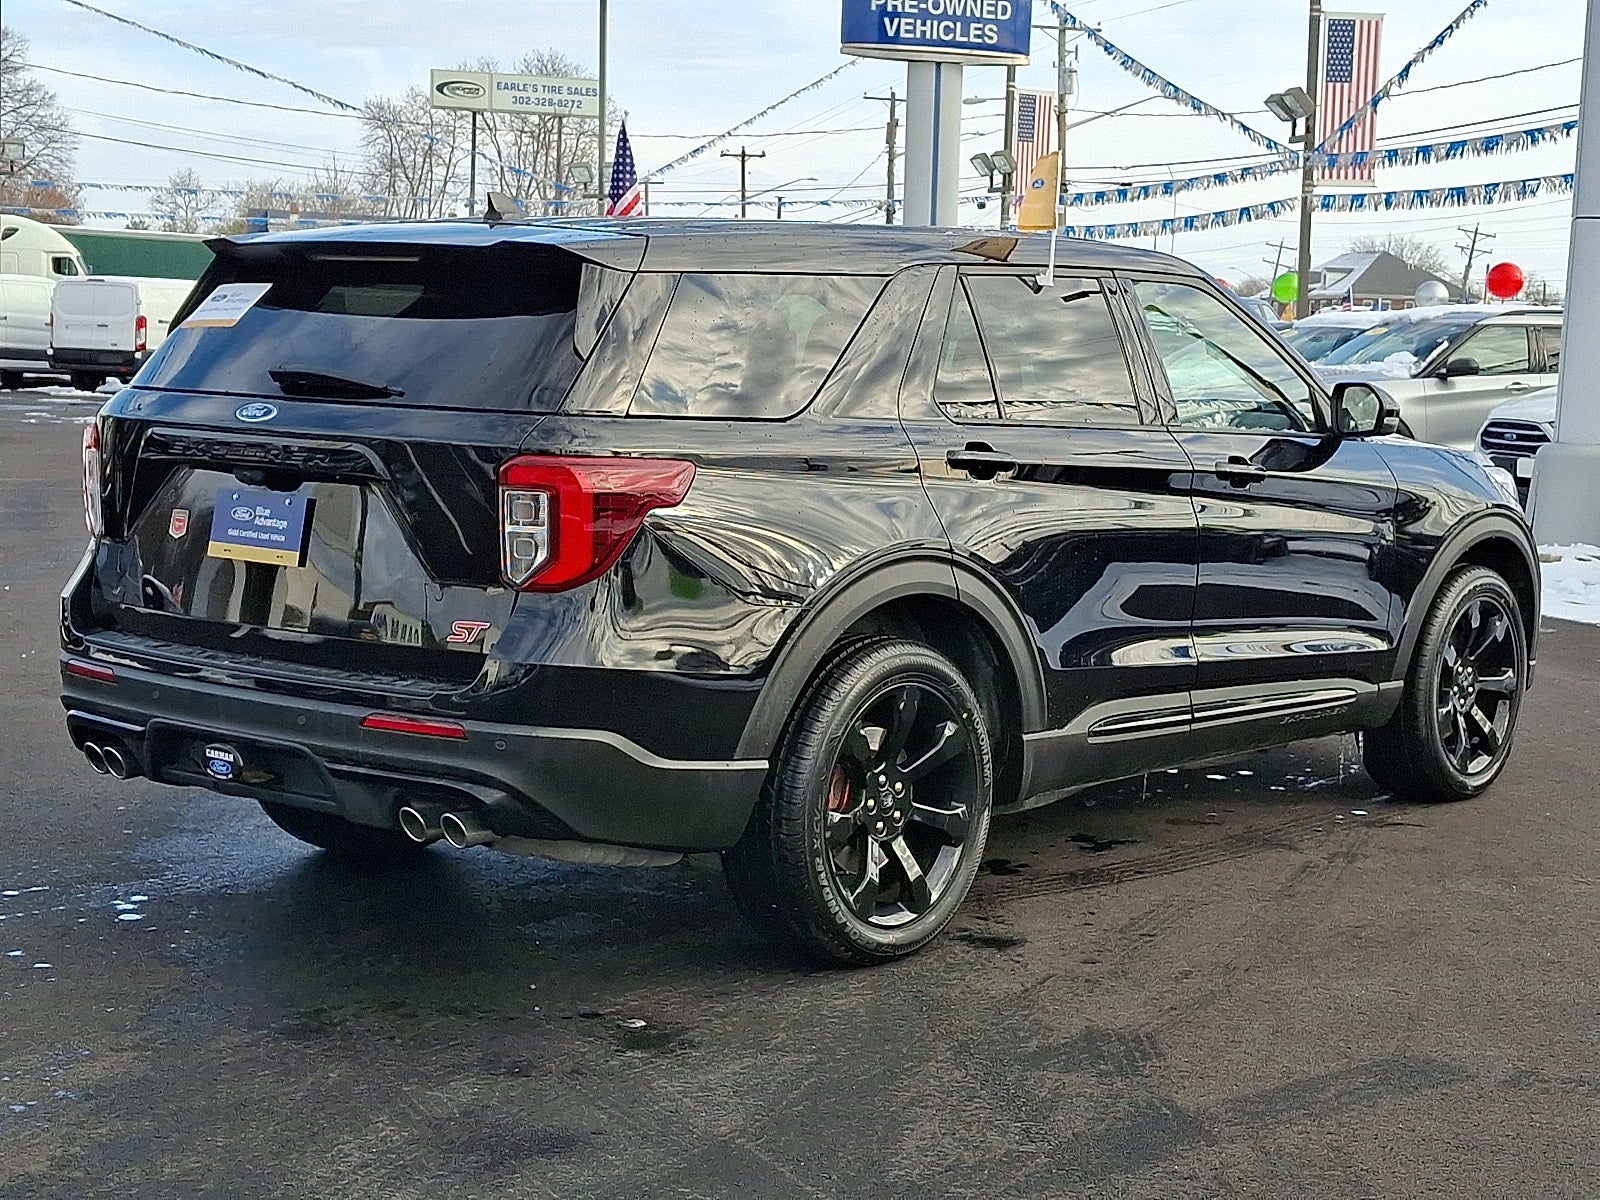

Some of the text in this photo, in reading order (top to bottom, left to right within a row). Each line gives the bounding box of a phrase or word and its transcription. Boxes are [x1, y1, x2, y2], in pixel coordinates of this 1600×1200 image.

[871, 0, 1012, 20] PRE-OWNED
[884, 17, 999, 44] VEHICLES
[496, 81, 598, 97] EARLE'S TIRE SALES
[511, 95, 583, 109] 302-328-8272
[255, 506, 271, 517] Blue
[254, 516, 288, 530] Advantage
[227, 528, 286, 542] Gold Certified Used Vehicle
[446, 620, 491, 643] ST
[206, 748, 234, 762] CARMAN
[972, 709, 991, 788] YOKOHAMA
[814, 856, 877, 949] GEOLANDAR
